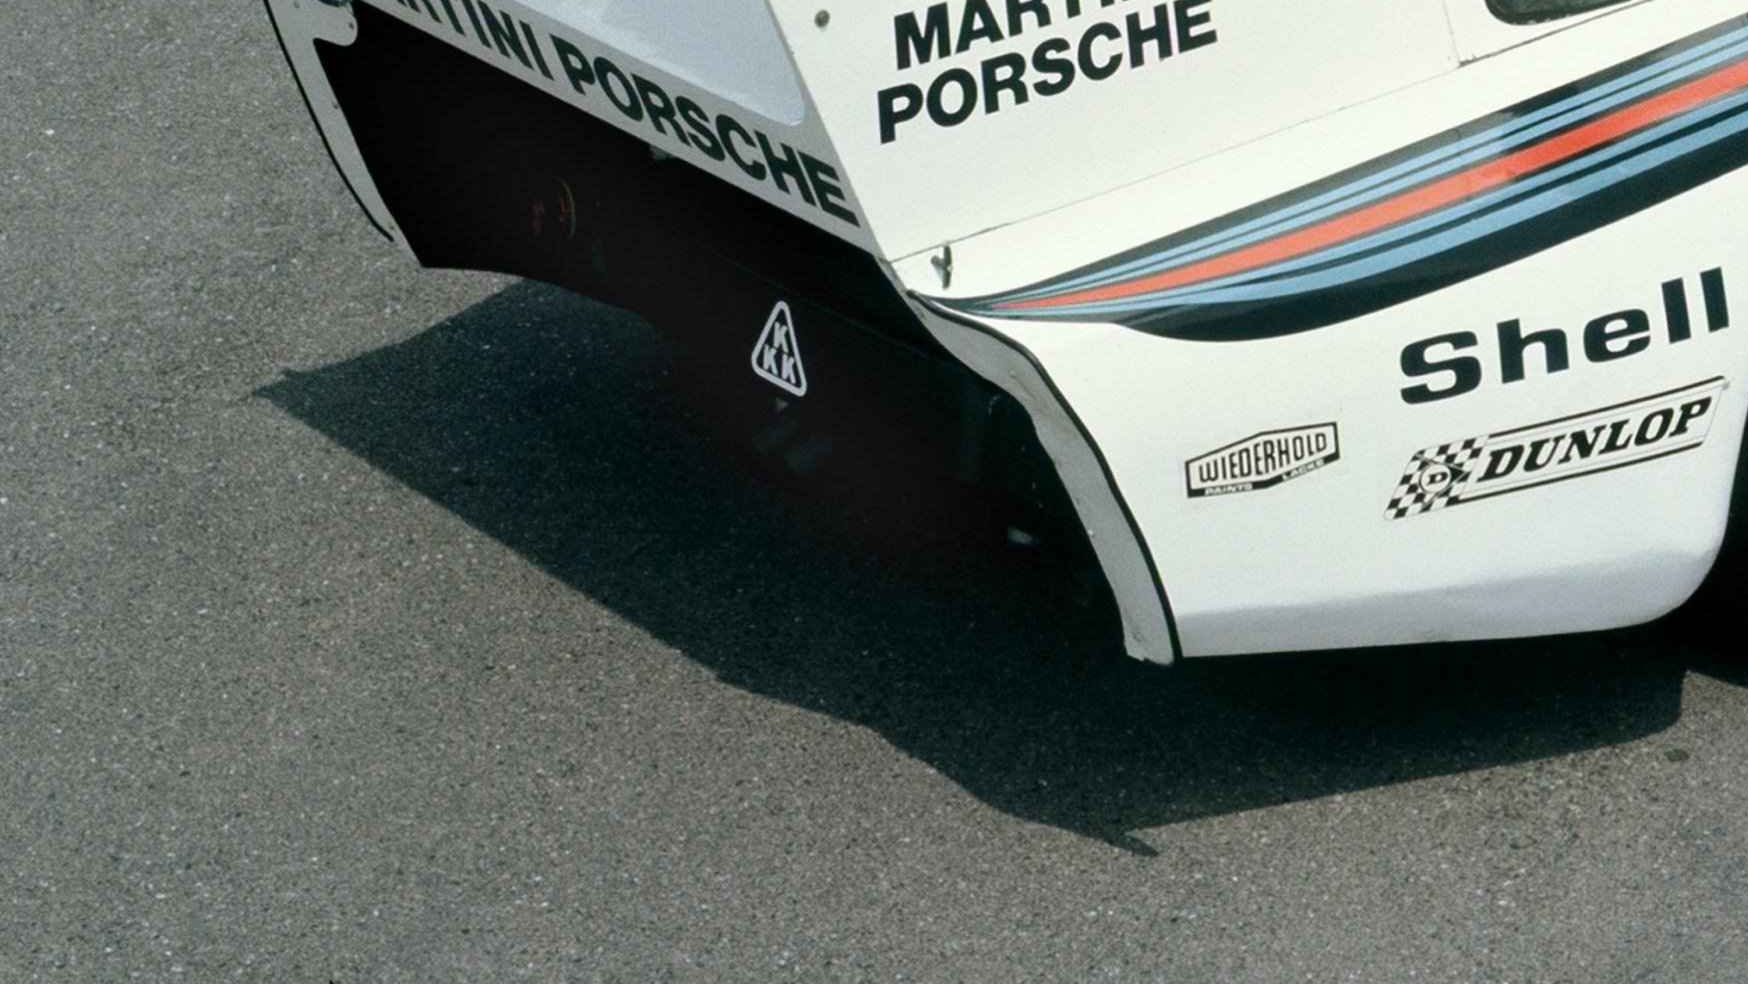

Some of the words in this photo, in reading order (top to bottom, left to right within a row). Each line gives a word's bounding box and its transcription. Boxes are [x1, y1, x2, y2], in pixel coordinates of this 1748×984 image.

[550, 33, 861, 227] PORSCHE
[1400, 267, 1729, 404] Shell
[1199, 432, 1327, 483] WIEDERHOLD
[1477, 397, 1712, 482] DUNLOP
[1204, 482, 1253, 496] PAINTS
